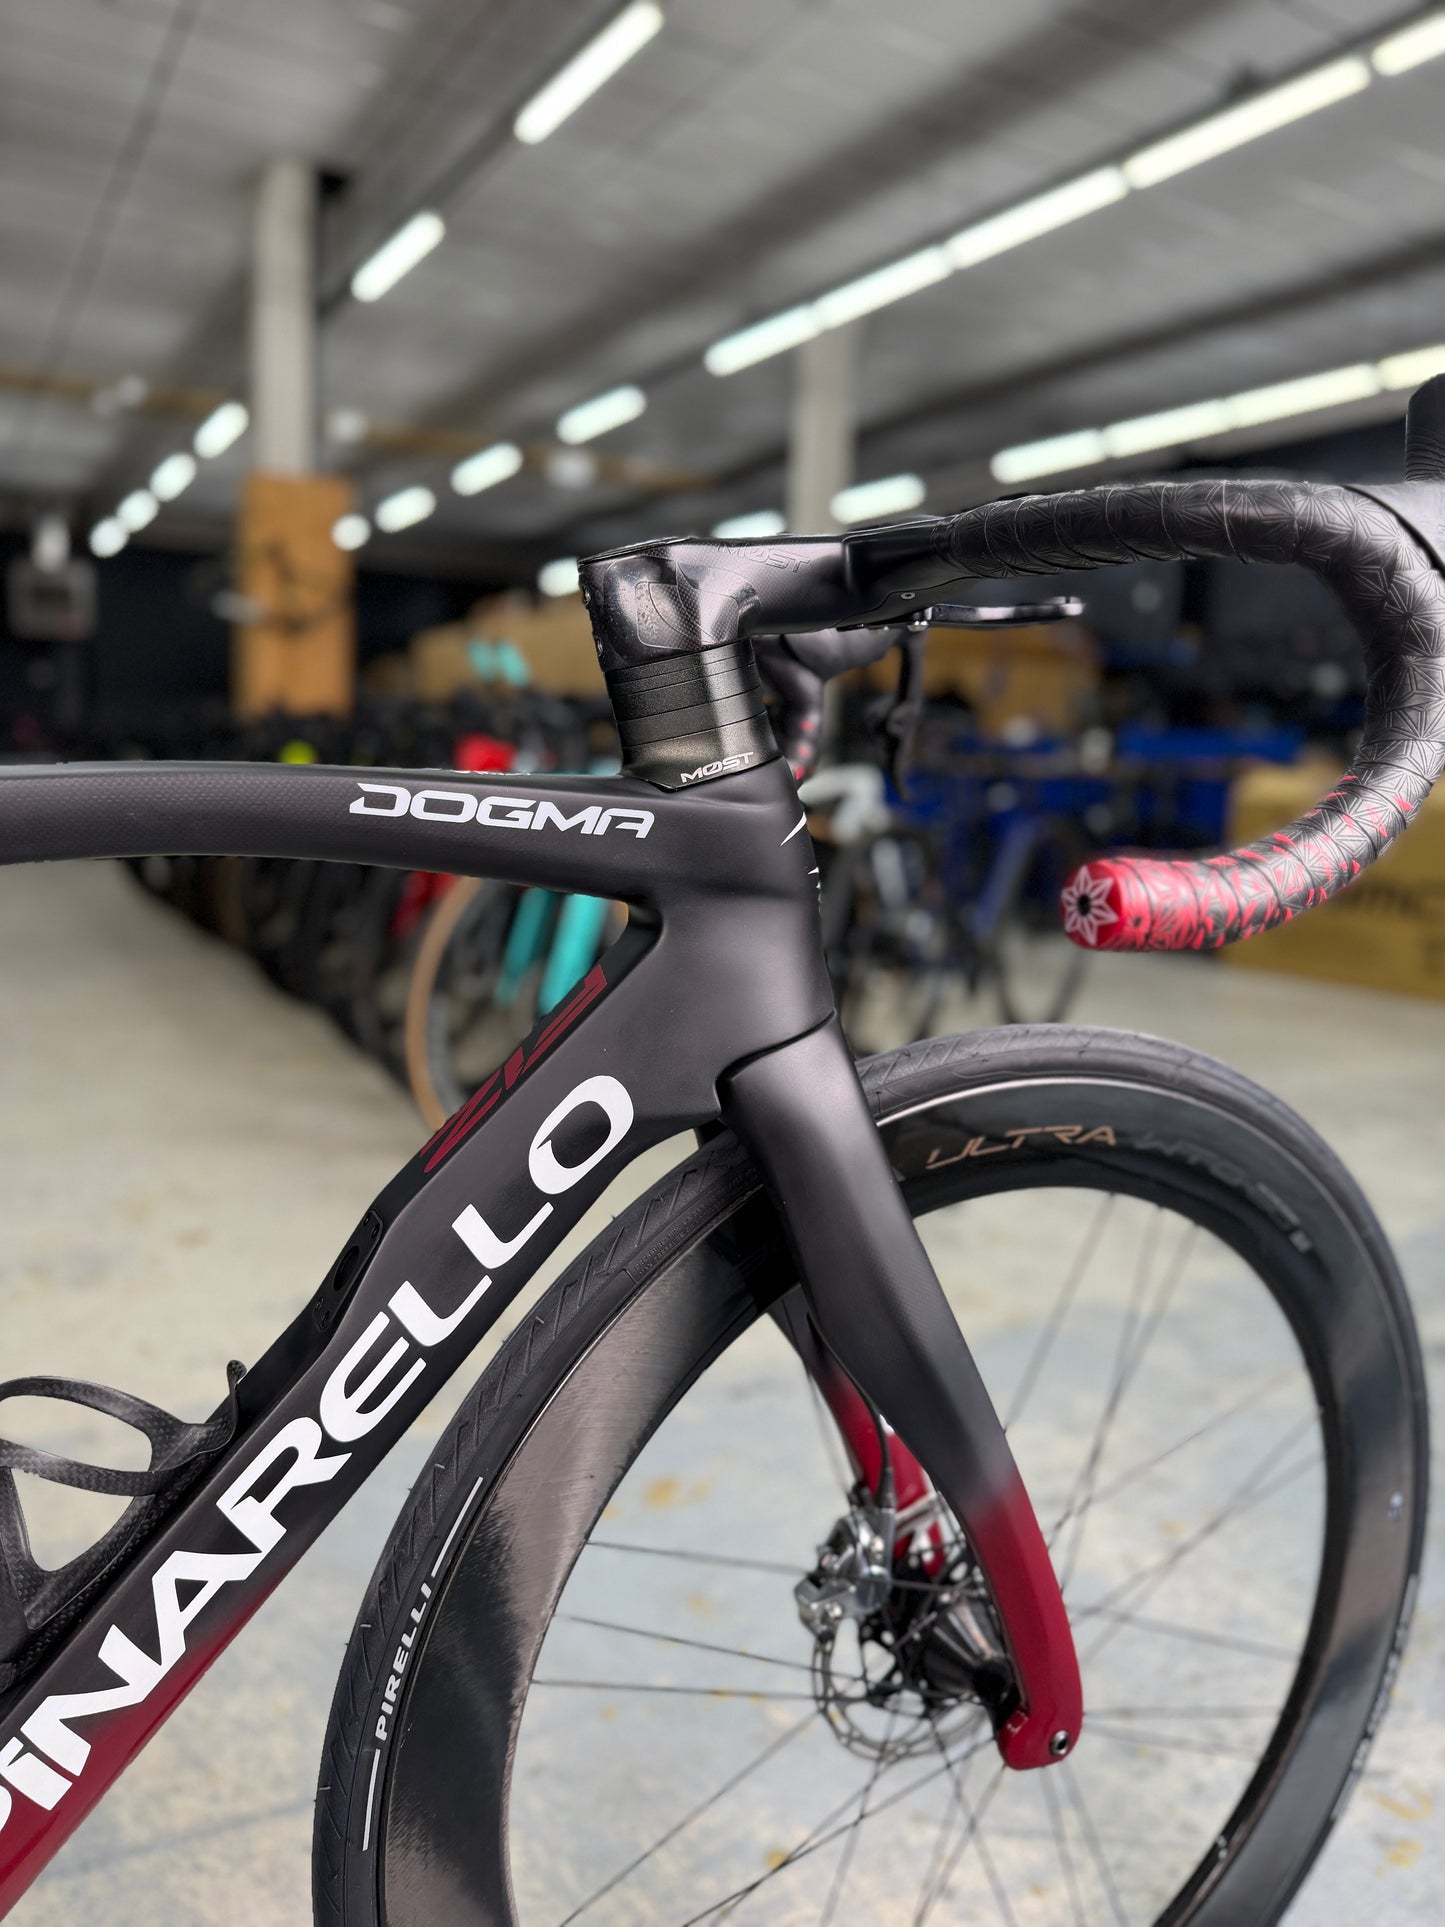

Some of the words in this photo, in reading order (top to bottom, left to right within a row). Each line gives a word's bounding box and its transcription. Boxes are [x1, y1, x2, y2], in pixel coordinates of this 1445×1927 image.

[350, 783, 655, 838] DOGMA
[925, 1125, 1117, 1170] ULTRA
[0, 1074, 635, 1832] INARELLO
[374, 1582, 432, 1741] PIRELLI
